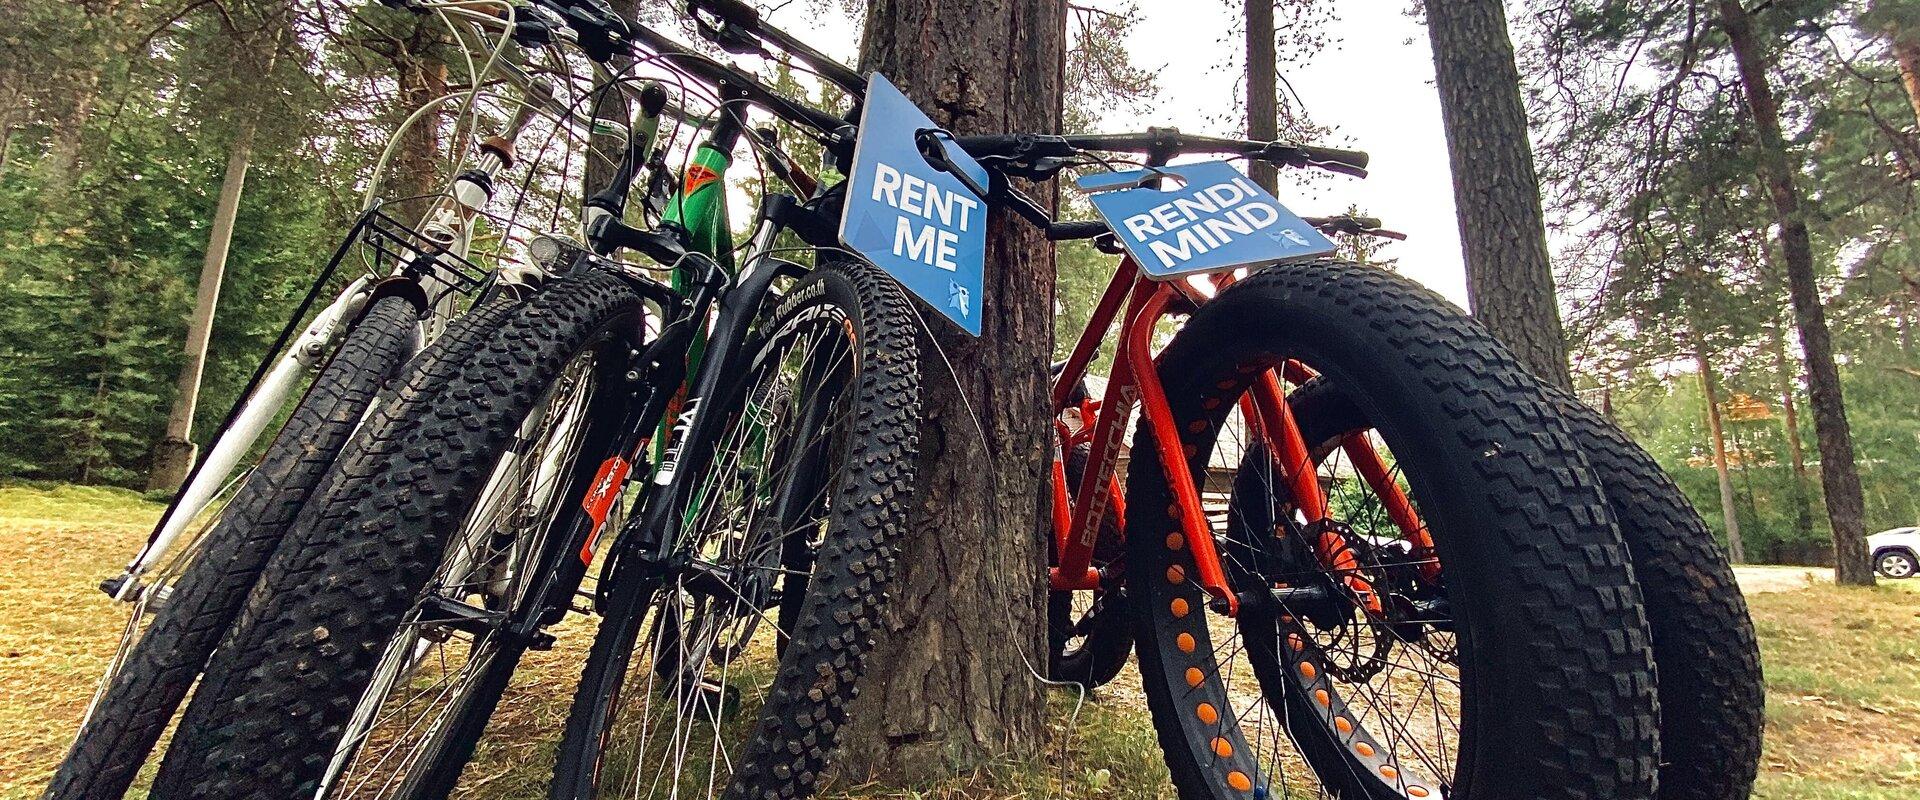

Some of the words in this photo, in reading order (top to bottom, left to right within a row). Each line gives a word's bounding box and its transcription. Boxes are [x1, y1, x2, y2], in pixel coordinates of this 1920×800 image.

[872, 162, 978, 232] RENT
[1123, 177, 1259, 243] RENDI
[893, 216, 959, 272] ME
[1148, 202, 1279, 269] MIND
[1080, 384, 1138, 548] BOTTECCHIA
